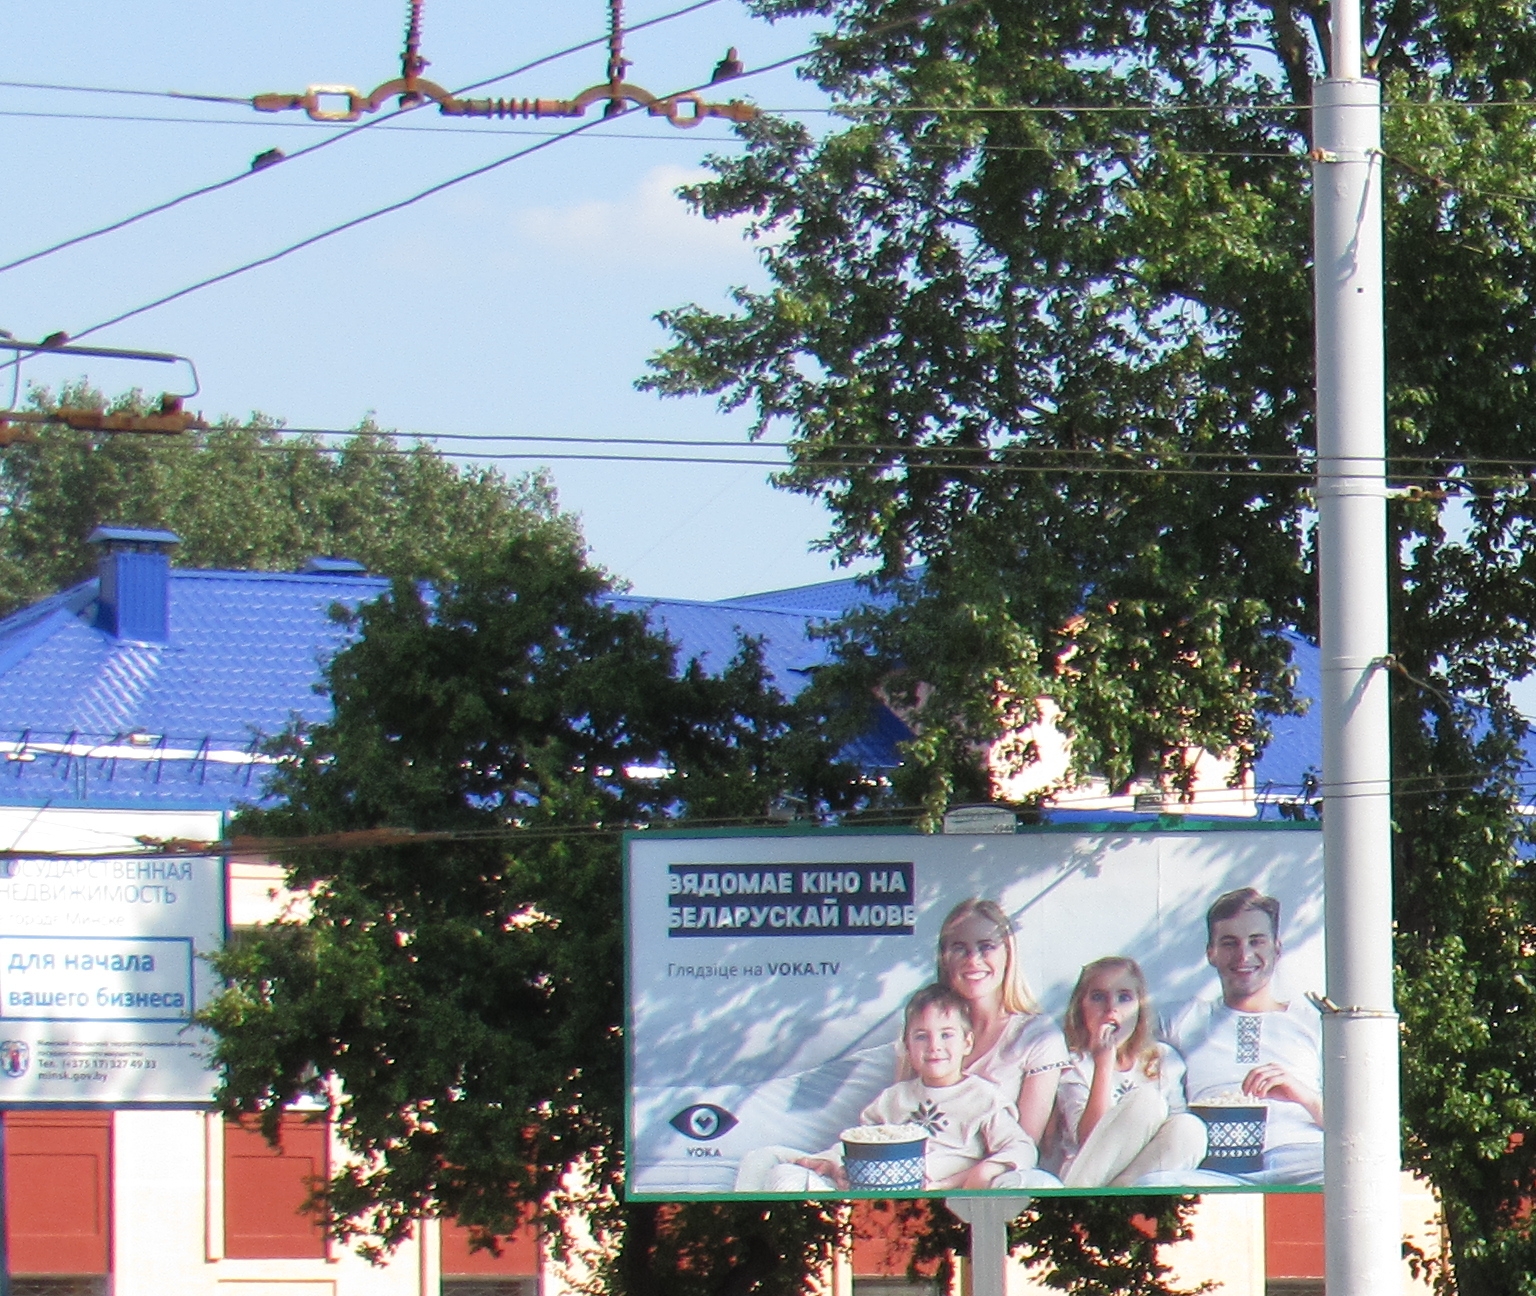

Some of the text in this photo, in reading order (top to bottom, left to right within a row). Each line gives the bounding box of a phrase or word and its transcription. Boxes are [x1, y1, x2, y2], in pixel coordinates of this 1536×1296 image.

[0, 861, 192, 881] ОСУДАРСТВЕННАЯ
[668, 871, 907, 897] ВЯДОМАЕ КІНО НА
[668, 898, 917, 929] БЕЛАРУСКАЙ МОВЕ
[8, 953, 155, 973] для начала
[668, 962, 840, 979] Глядзіце на VOKA.TV
[9, 987, 185, 1007] вашего бизнеса
[687, 1147, 722, 1158] VOKA
